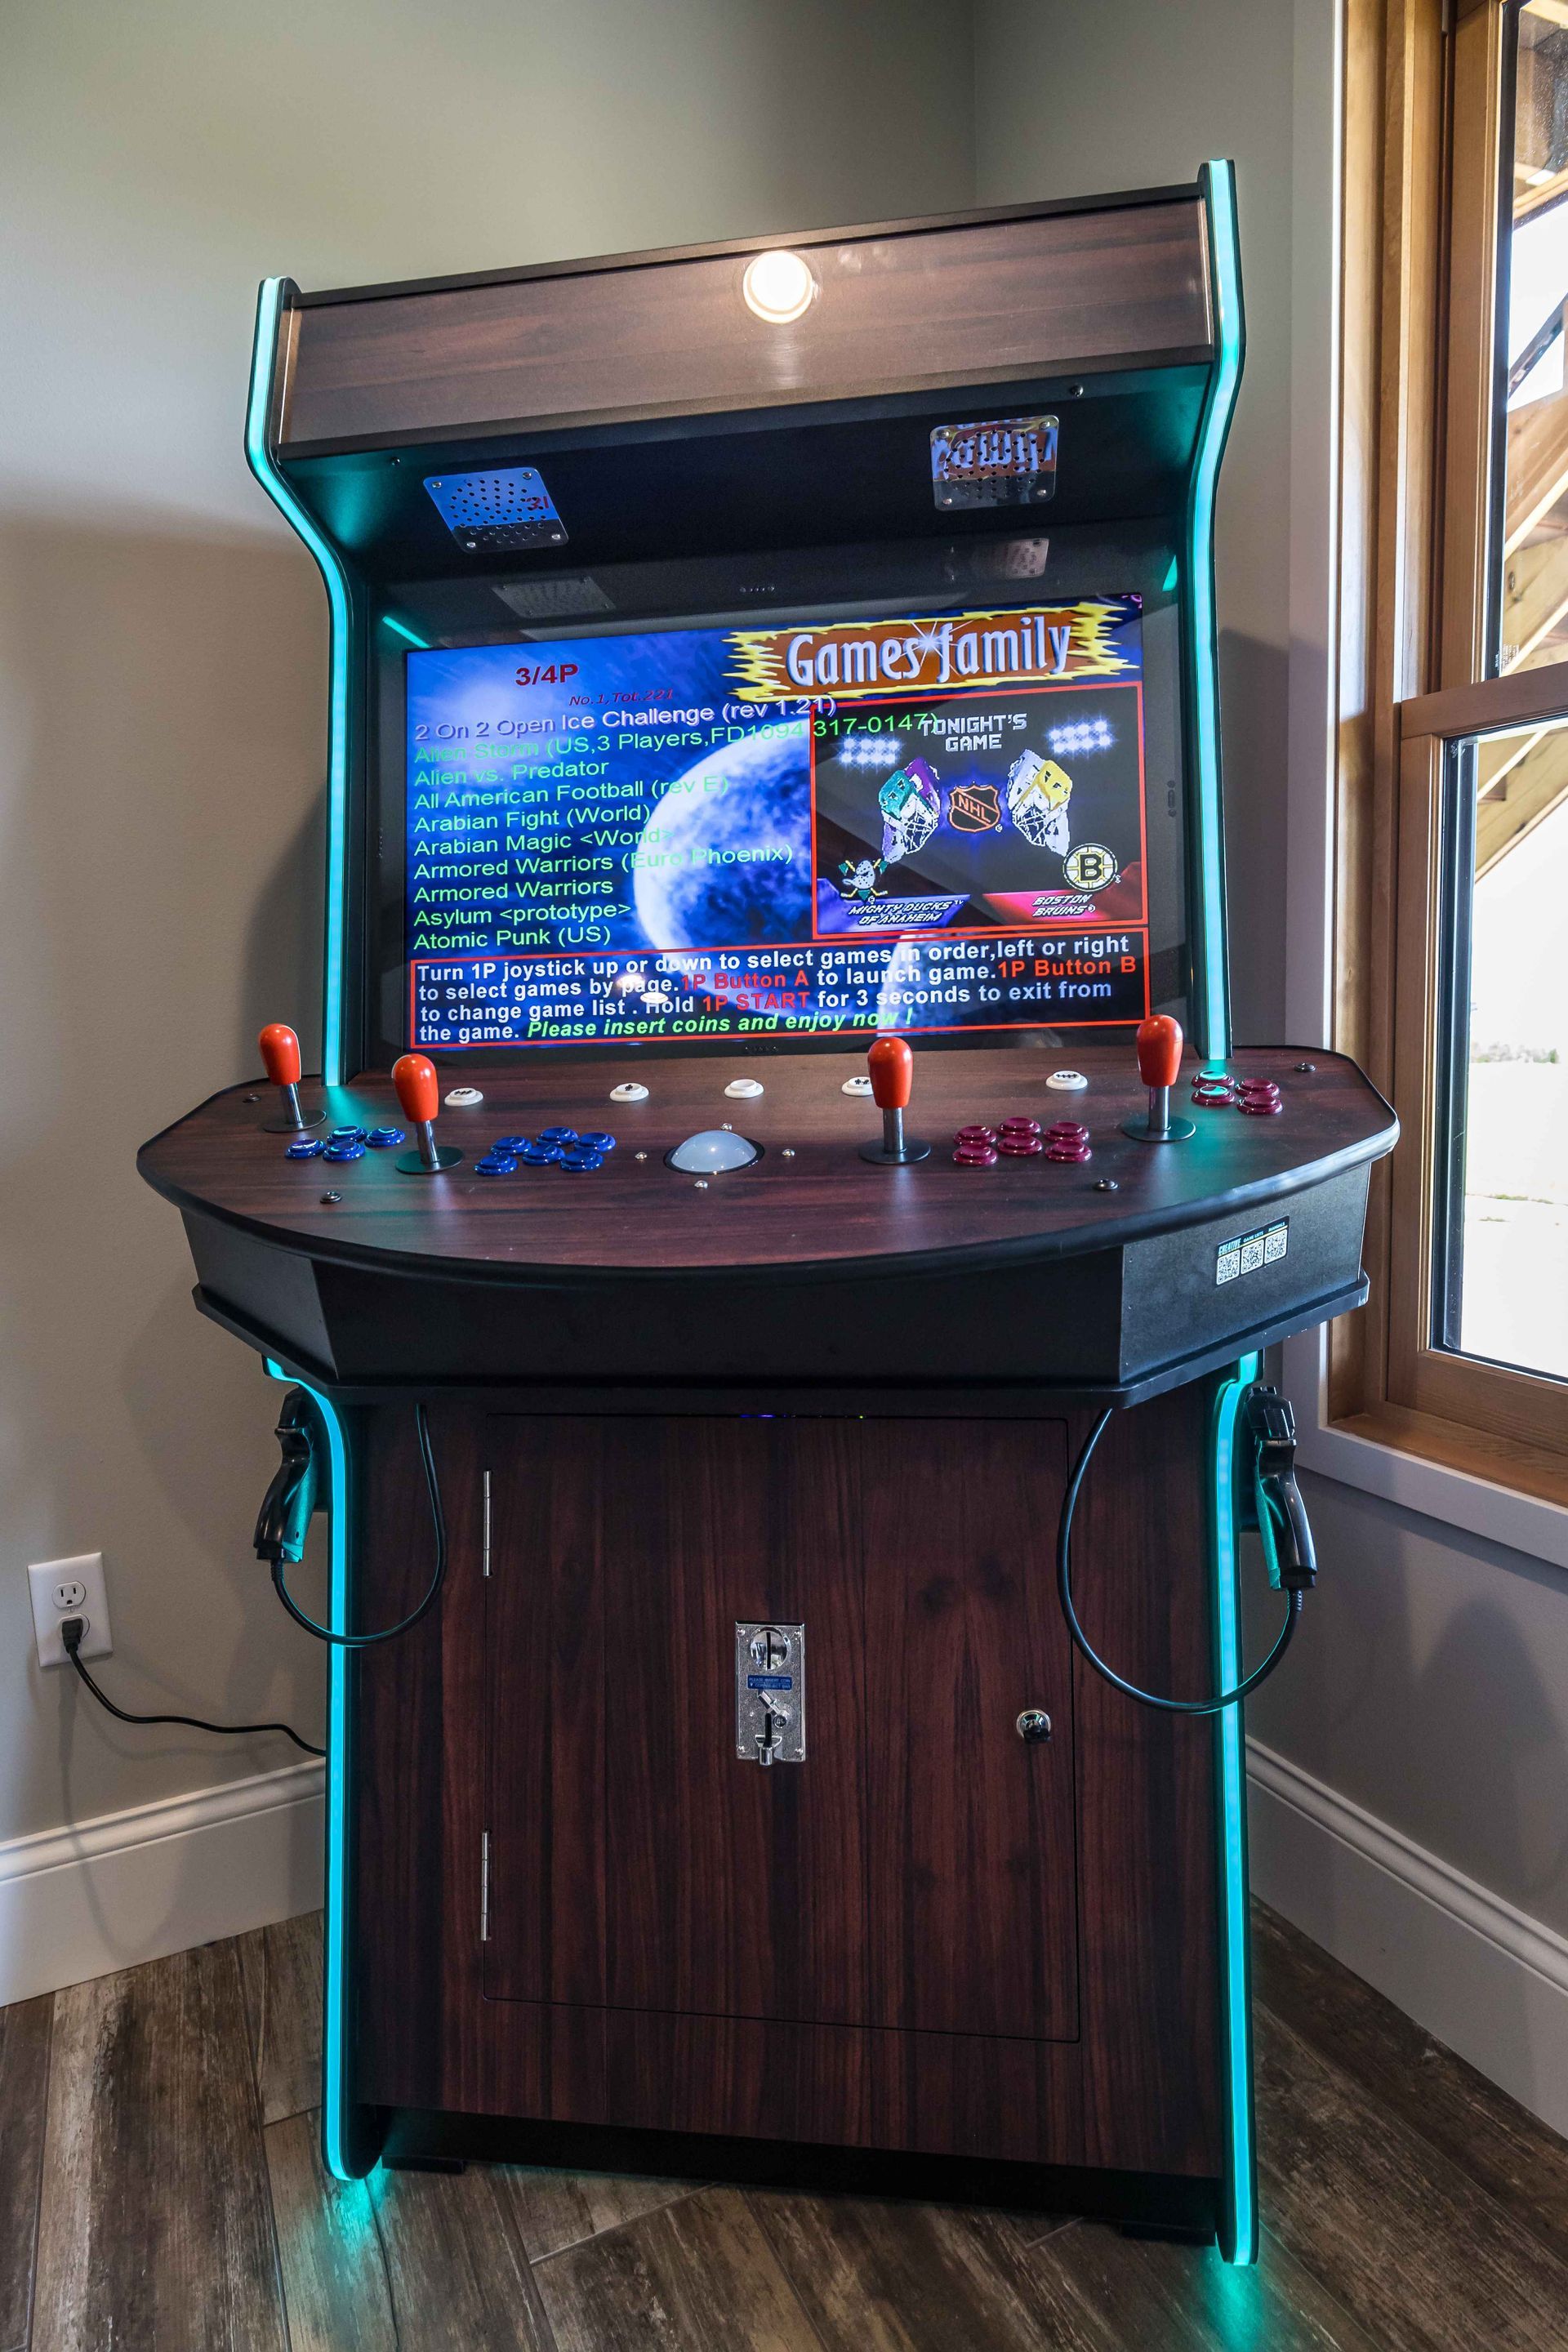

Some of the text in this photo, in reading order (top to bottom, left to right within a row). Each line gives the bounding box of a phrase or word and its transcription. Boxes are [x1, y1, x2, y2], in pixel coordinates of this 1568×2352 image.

[786, 616, 1071, 687] Games family
[514, 663, 579, 686] 3/4P
[415, 695, 837, 741] 2 On 2 Open Ice Challenge (rev 1.21)
[415, 746, 466, 764] Alien
[474, 742, 539, 760] Storm
[546, 735, 611, 759] (US,3
[813, 713, 938, 737] 317-0147)
[945, 734, 1003, 752] GAME
[414, 761, 609, 786] Alien vs. Predator
[414, 776, 728, 809] All American Football (rev E)
[414, 804, 651, 833] Arabian Fight (World)
[958, 794, 991, 823] NHL
[414, 827, 675, 856] Arabian Magic <World>
[414, 844, 793, 880] Armored Warriors (Euro Phoenix)
[1079, 853, 1102, 881] B
[414, 879, 613, 903] Armored Warriors
[1032, 893, 1093, 907] BOSTON
[414, 903, 632, 929] Asylum <prototype>
[848, 903, 902, 915] MIGHTY
[858, 912, 942, 925] OF ANAHEIM
[413, 925, 611, 949] Atomic Punk (US)
[417, 964, 464, 982] Turn
[471, 962, 497, 979] 1P
[503, 959, 586, 982] joystick
[593, 960, 618, 978] up
[626, 959, 648, 973] or
[655, 954, 711, 973] down
[719, 953, 741, 970] to
[747, 950, 814, 969] select
[821, 949, 892, 969] games
[901, 946, 920, 962] in
[1042, 942, 1067, 956] or
[1074, 935, 1129, 958] right
[419, 984, 439, 1001] to
[446, 982, 508, 1000] select
[514, 981, 582, 1001] games
[590, 978, 614, 998] by
[714, 972, 786, 990] Button
[794, 969, 810, 987] A
[817, 970, 839, 986] to
[847, 964, 920, 984] launch
[1034, 959, 1111, 977] Button
[1120, 956, 1137, 973] B
[421, 1005, 441, 1022] to
[448, 1004, 522, 1023] change
[528, 1003, 585, 1022] game
[592, 999, 626, 1016] list
[646, 996, 694, 1015] Hold
[702, 995, 728, 1013] 1P
[736, 991, 811, 1011] START
[817, 990, 849, 1008] for
[856, 989, 869, 1007] 3
[876, 985, 970, 1006] seconds
[978, 984, 1001, 1001] to
[1009, 982, 1053, 1000] exit
[1058, 980, 1111, 999] from
[419, 1025, 452, 1042] the
[458, 1024, 520, 1045] game.
[528, 1021, 597, 1039] Please
[604, 1017, 666, 1036] insert
[671, 1015, 731, 1034] coins
[738, 1012, 780, 1031] and
[785, 1010, 847, 1033] enjoy
[852, 1011, 900, 1027] now
